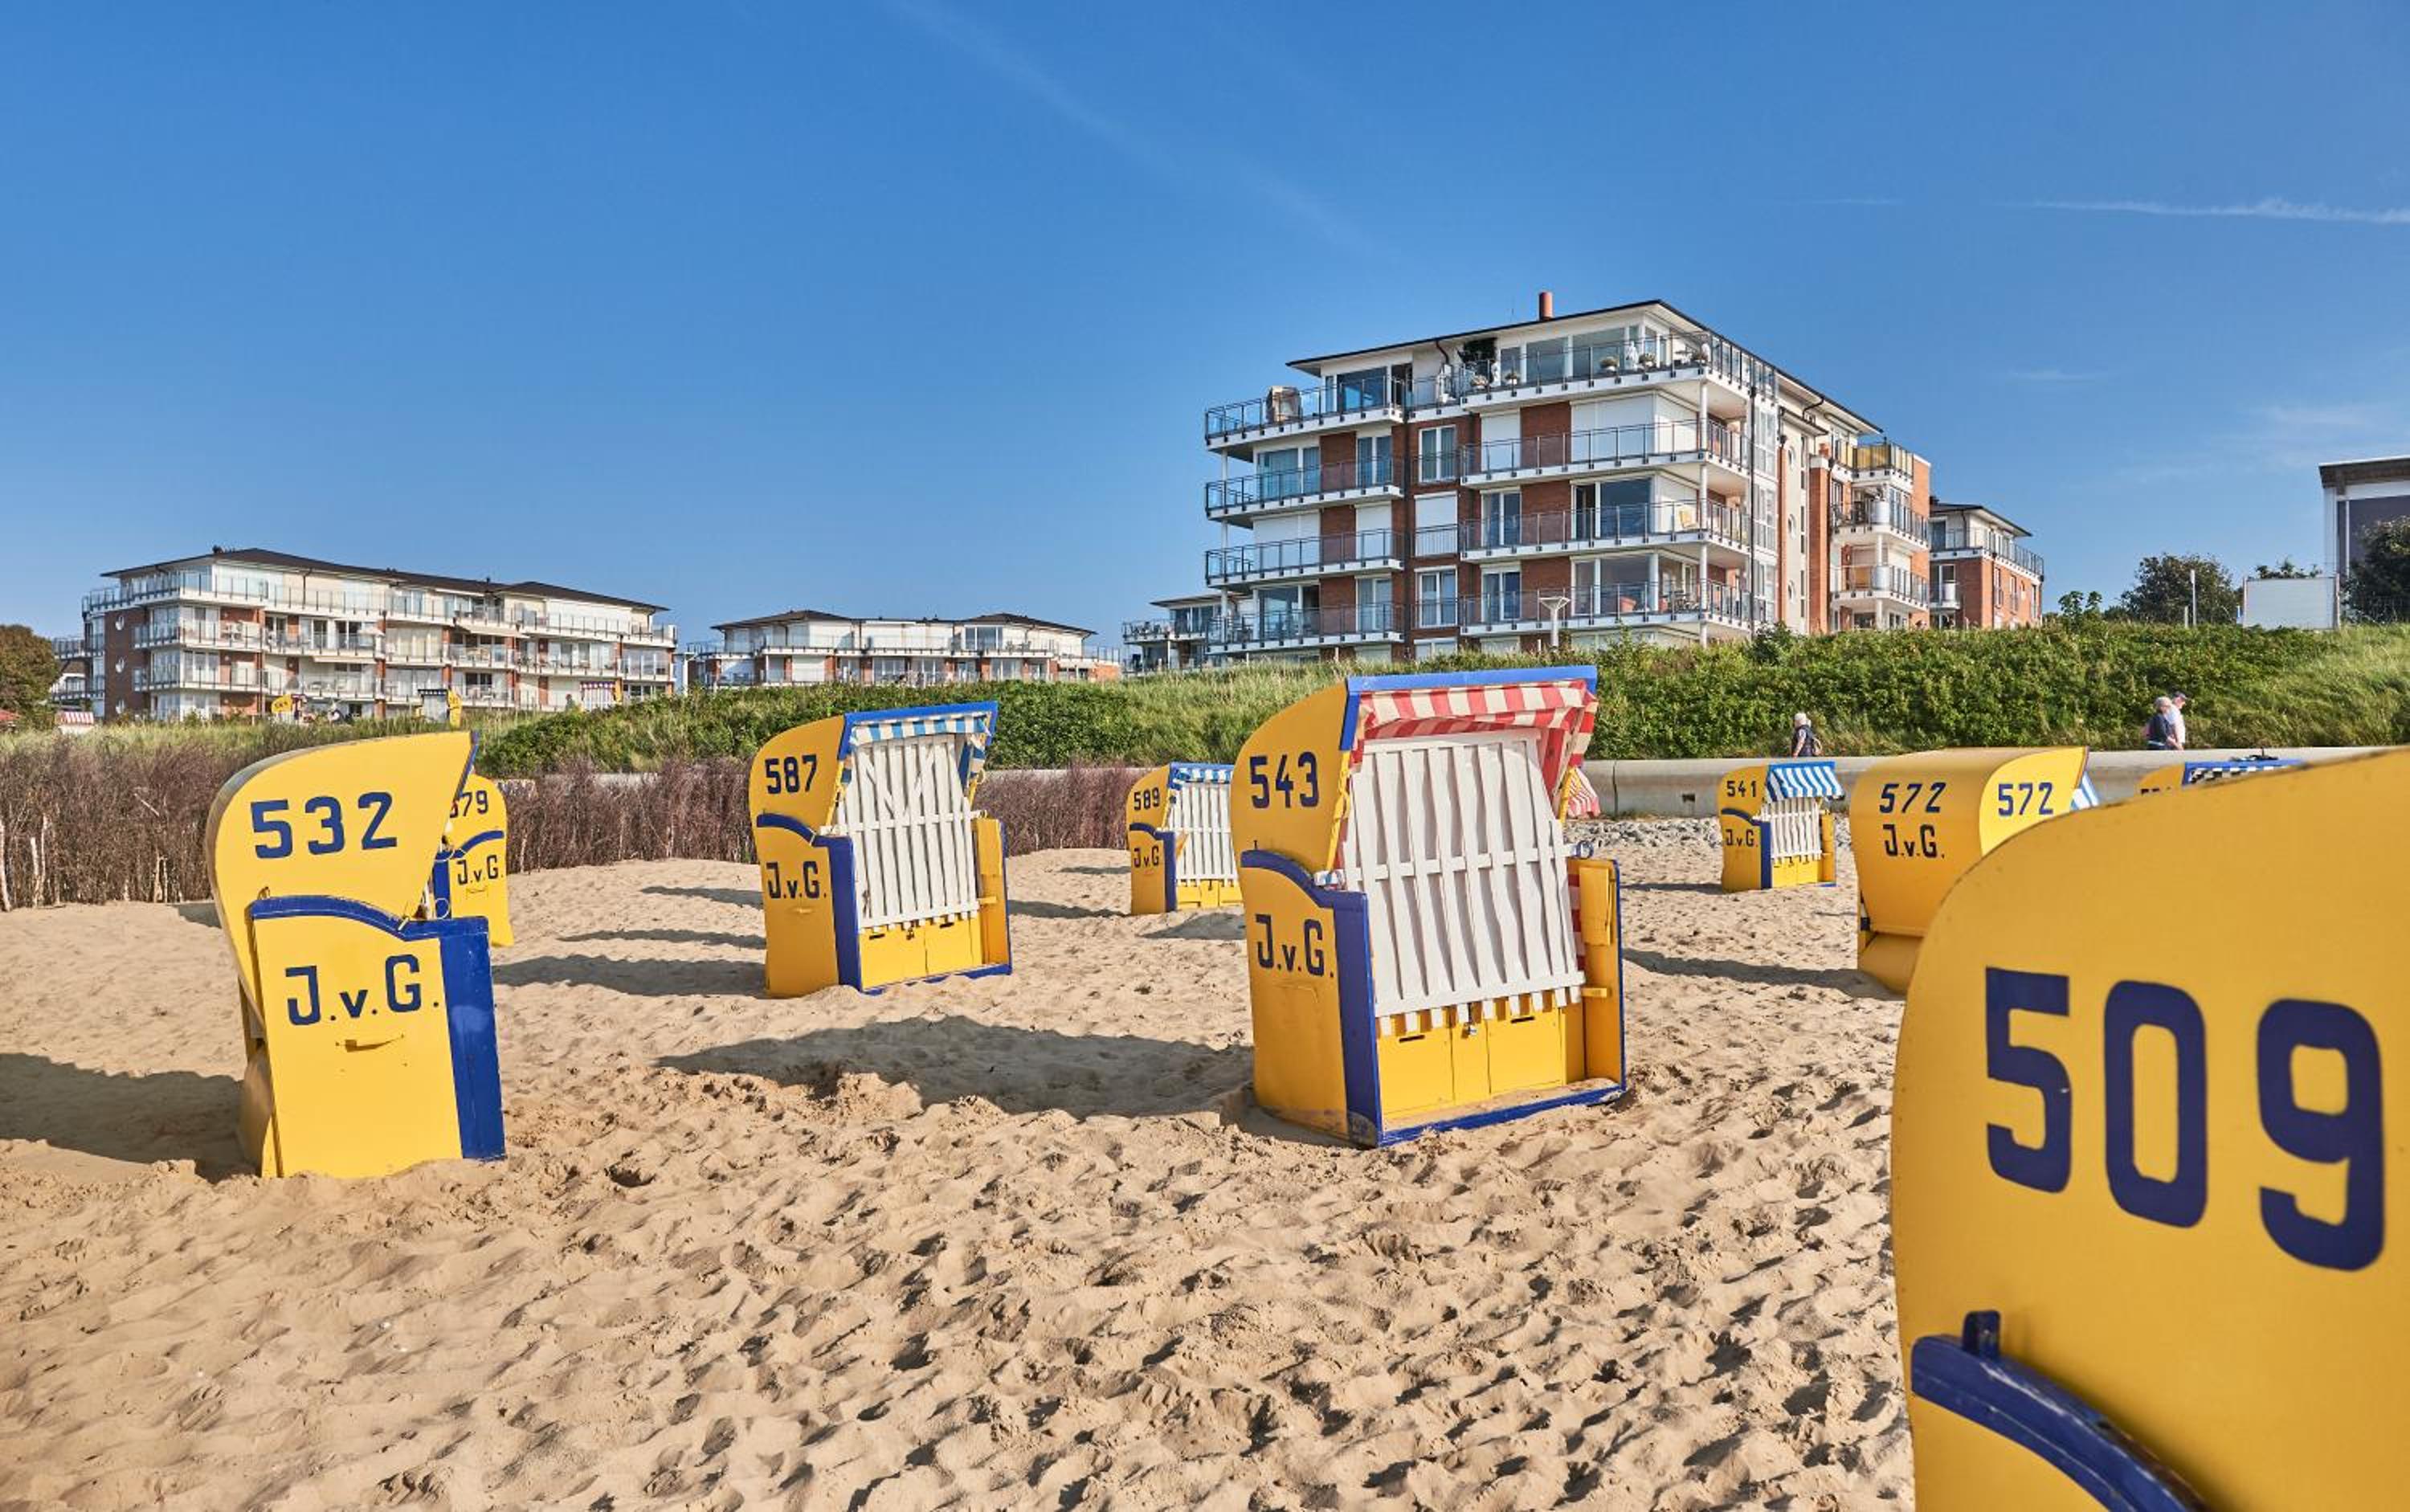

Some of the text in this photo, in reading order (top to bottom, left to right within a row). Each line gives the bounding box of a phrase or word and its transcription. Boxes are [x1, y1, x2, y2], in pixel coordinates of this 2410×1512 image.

[765, 754, 818, 794] 587
[1249, 751, 1319, 808] 543
[1726, 780, 1757, 797] 541
[1134, 787, 1160, 810] 589
[1879, 782, 1946, 813] 572
[1998, 782, 2054, 816] 572
[251, 791, 398, 858] 532
[1882, 823, 1945, 859] J.v.G.
[766, 860, 827, 898] J.v.G.
[1255, 913, 1334, 978] J.v.G.
[285, 954, 439, 1025] J.v.G.
[1985, 966, 2385, 1273] 509
